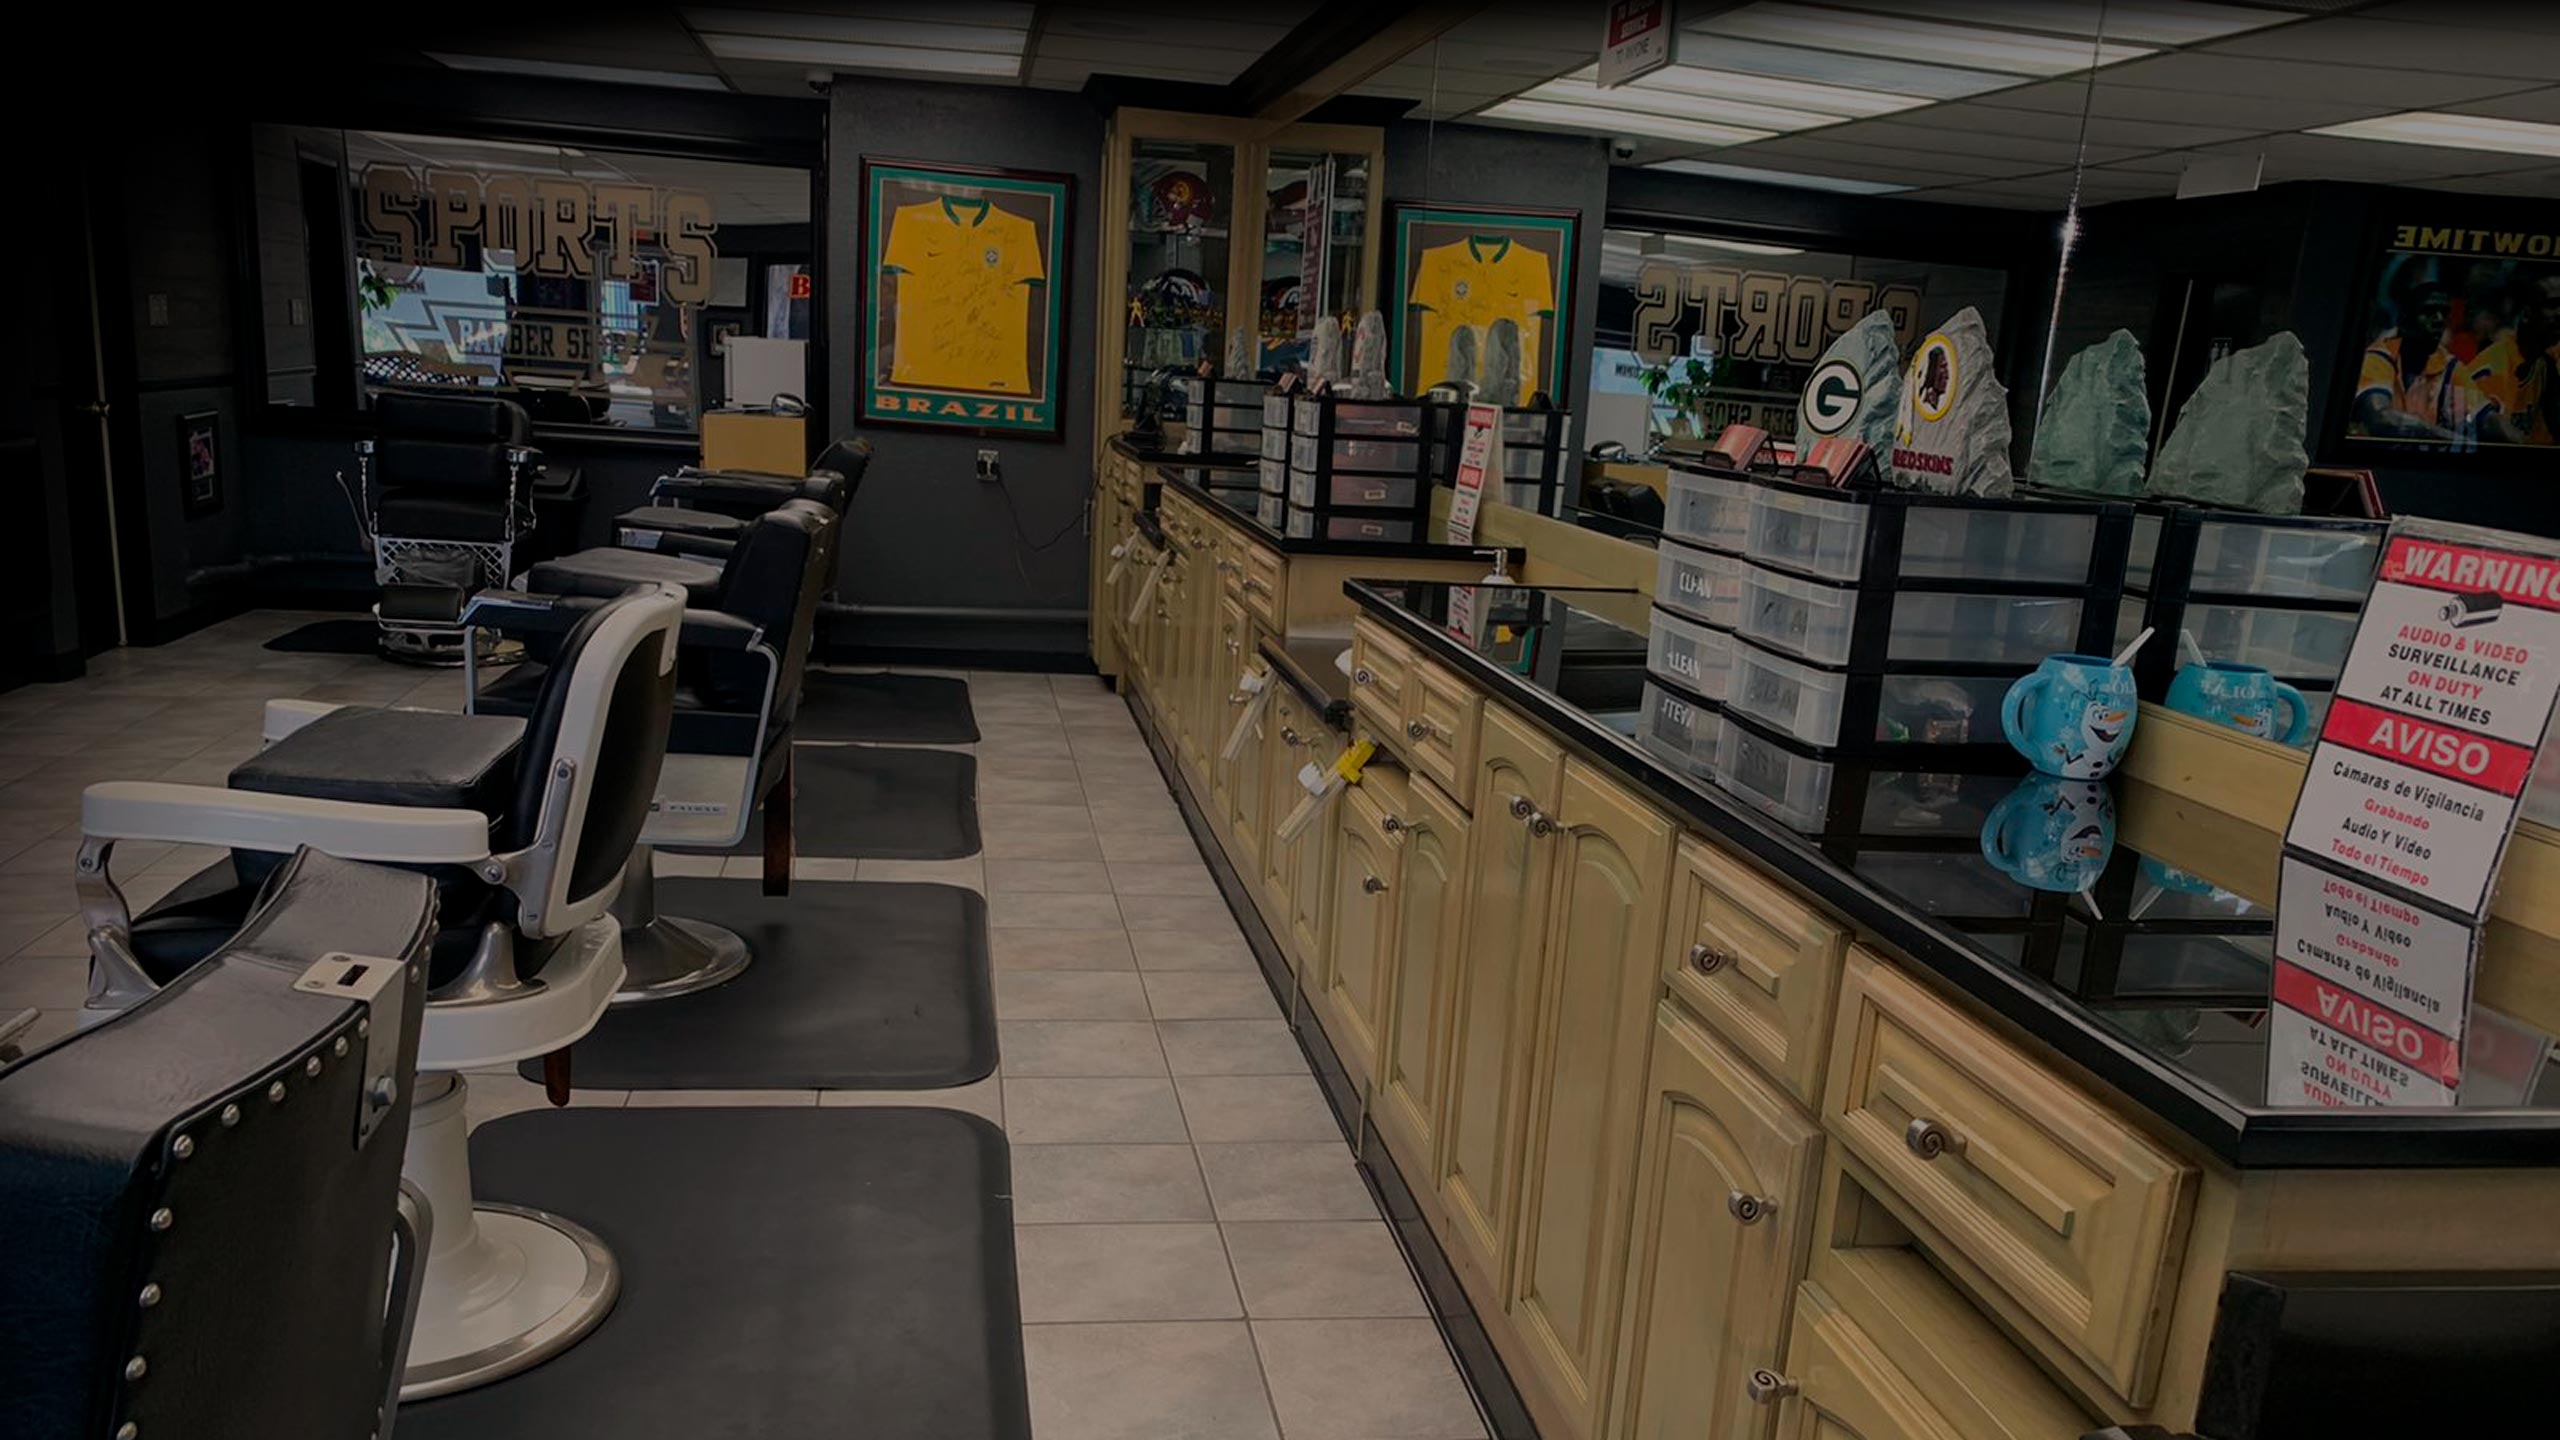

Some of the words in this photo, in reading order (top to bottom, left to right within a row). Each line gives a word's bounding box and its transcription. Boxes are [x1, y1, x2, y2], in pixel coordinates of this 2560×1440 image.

[360, 161, 718, 308] SPORTS
[875, 394, 1044, 422] BRAZIL
[1804, 361, 1862, 434] G
[1893, 449, 1953, 475] REDSKINS
[2388, 644, 2520, 686] SURVEILLANCE
[2398, 625, 2451, 647] AUDIO
[2455, 637, 2466, 650] &
[2474, 640, 2528, 664] VIDEO
[2381, 686, 2402, 700] AT
[2403, 693, 2433, 711] ALL
[2439, 700, 2491, 725] TIMES
[2408, 670, 2432, 688] ON
[2436, 677, 2483, 700] DUTY
[2368, 718, 2490, 775] AVISO
[2364, 798, 2430, 830] Grabando
[2394, 781, 2411, 797] de
[2415, 785, 2484, 822] Vigilancia
[2342, 817, 2377, 840] Audio
[2382, 829, 2392, 844] Y
[2395, 835, 2431, 860] Video
[2332, 838, 2362, 861] Todo
[2364, 851, 2377, 866] el
[2380, 856, 2430, 886] Tiempo
